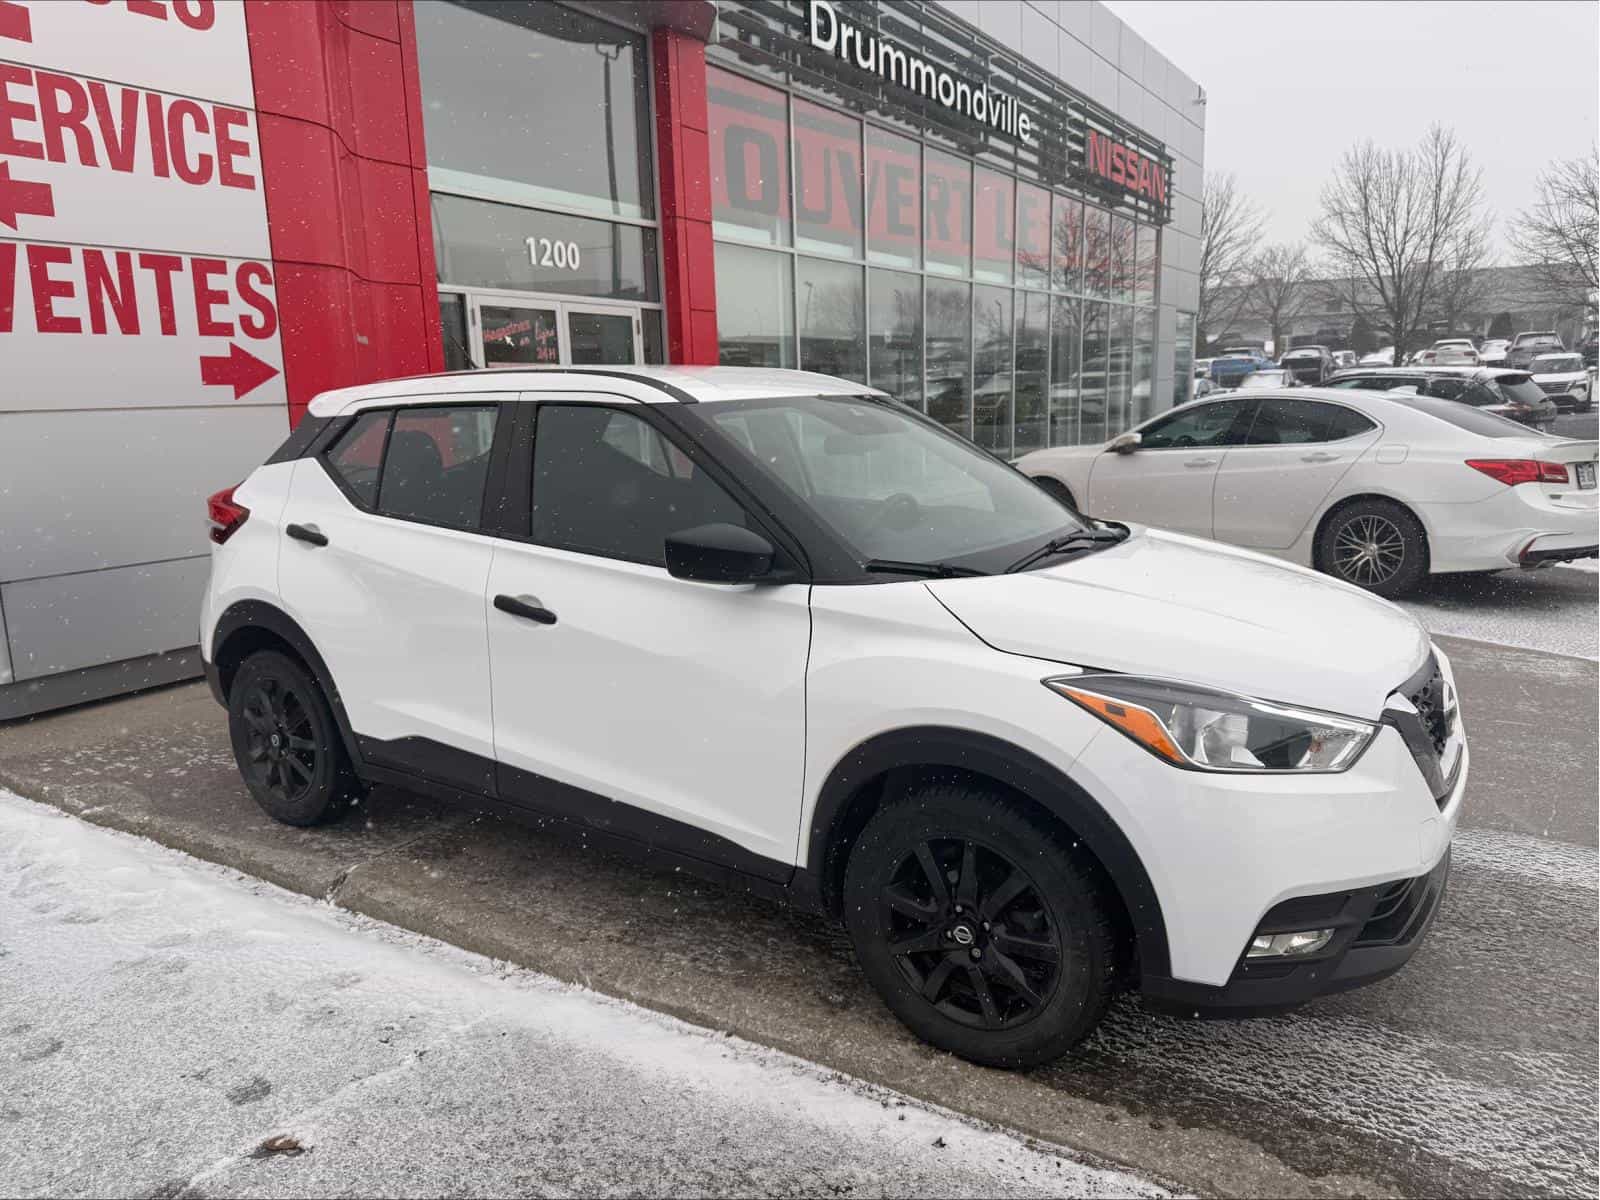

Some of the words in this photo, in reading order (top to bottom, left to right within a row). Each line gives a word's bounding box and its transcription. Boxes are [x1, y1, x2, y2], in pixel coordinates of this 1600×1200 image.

[810, 0, 1031, 142] Drummondville
[724, 123, 979, 242] OUVERT
[1087, 129, 1167, 204] NISSAN
[525, 236, 581, 270] 1200
